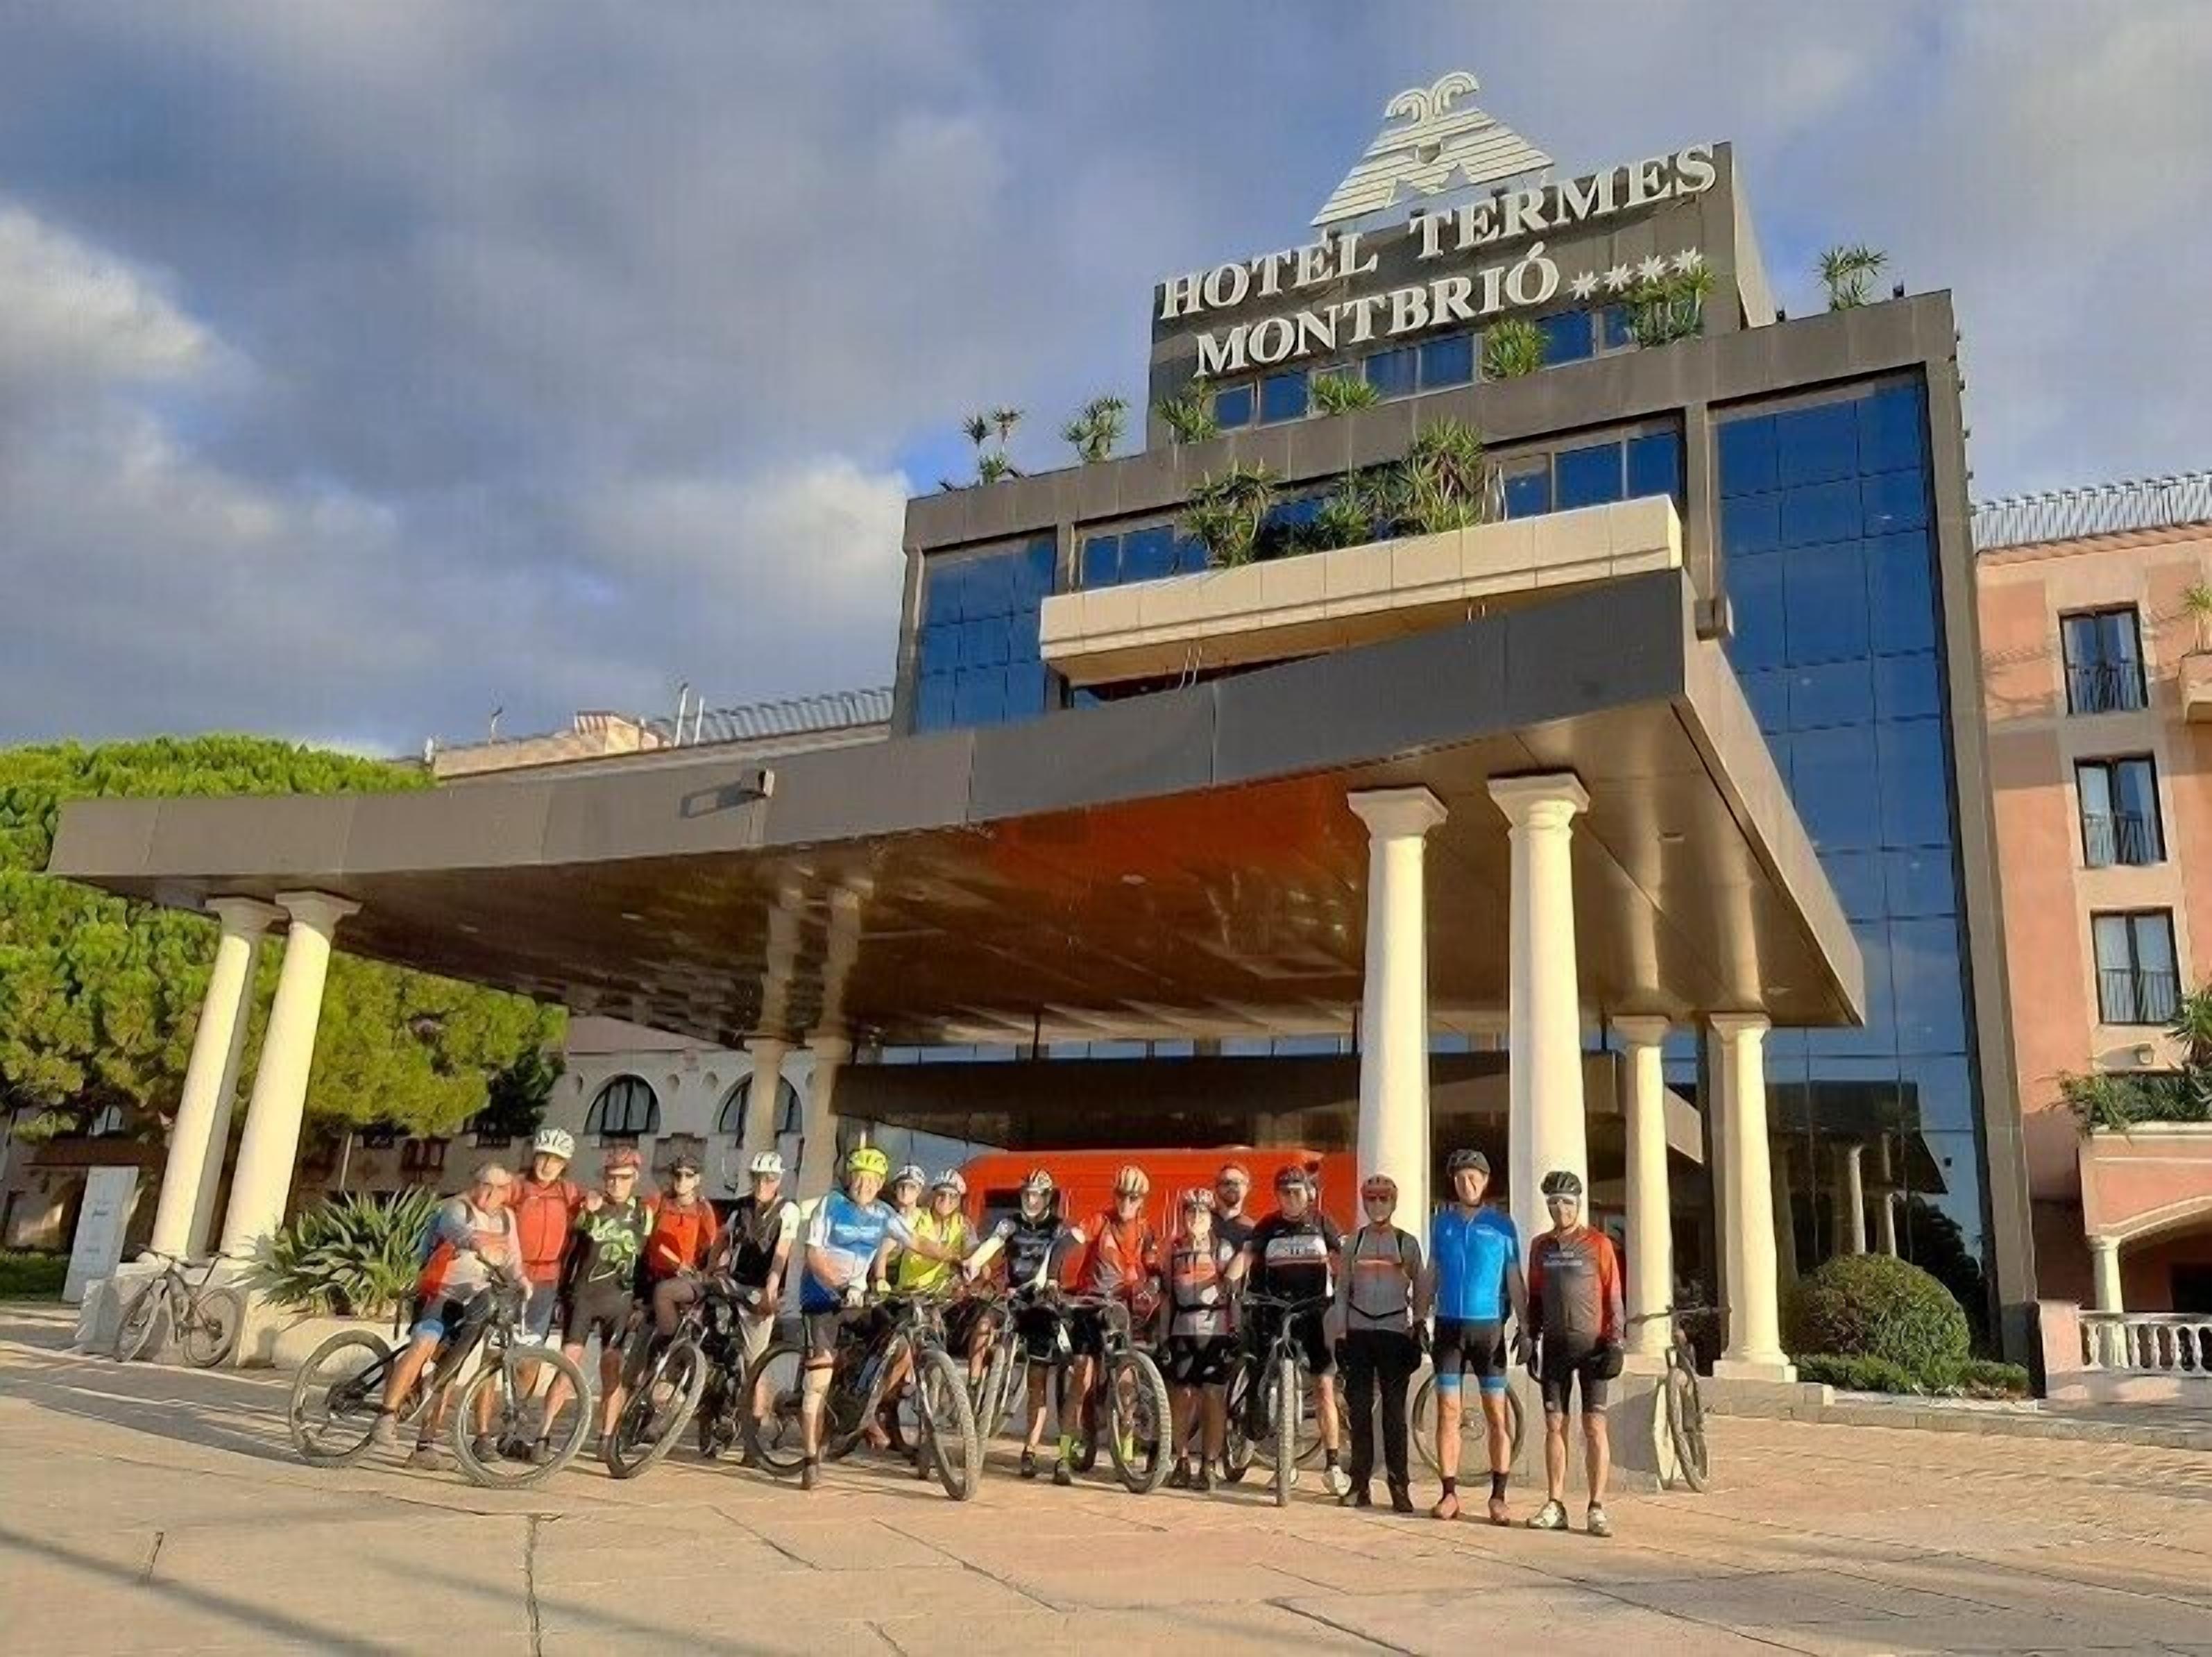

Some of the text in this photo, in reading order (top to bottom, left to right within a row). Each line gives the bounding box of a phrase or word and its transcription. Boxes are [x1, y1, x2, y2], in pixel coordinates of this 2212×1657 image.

[1159, 144, 1717, 319] HOTEL TERMES
[1193, 242, 1560, 377] MONTBRIÓ
